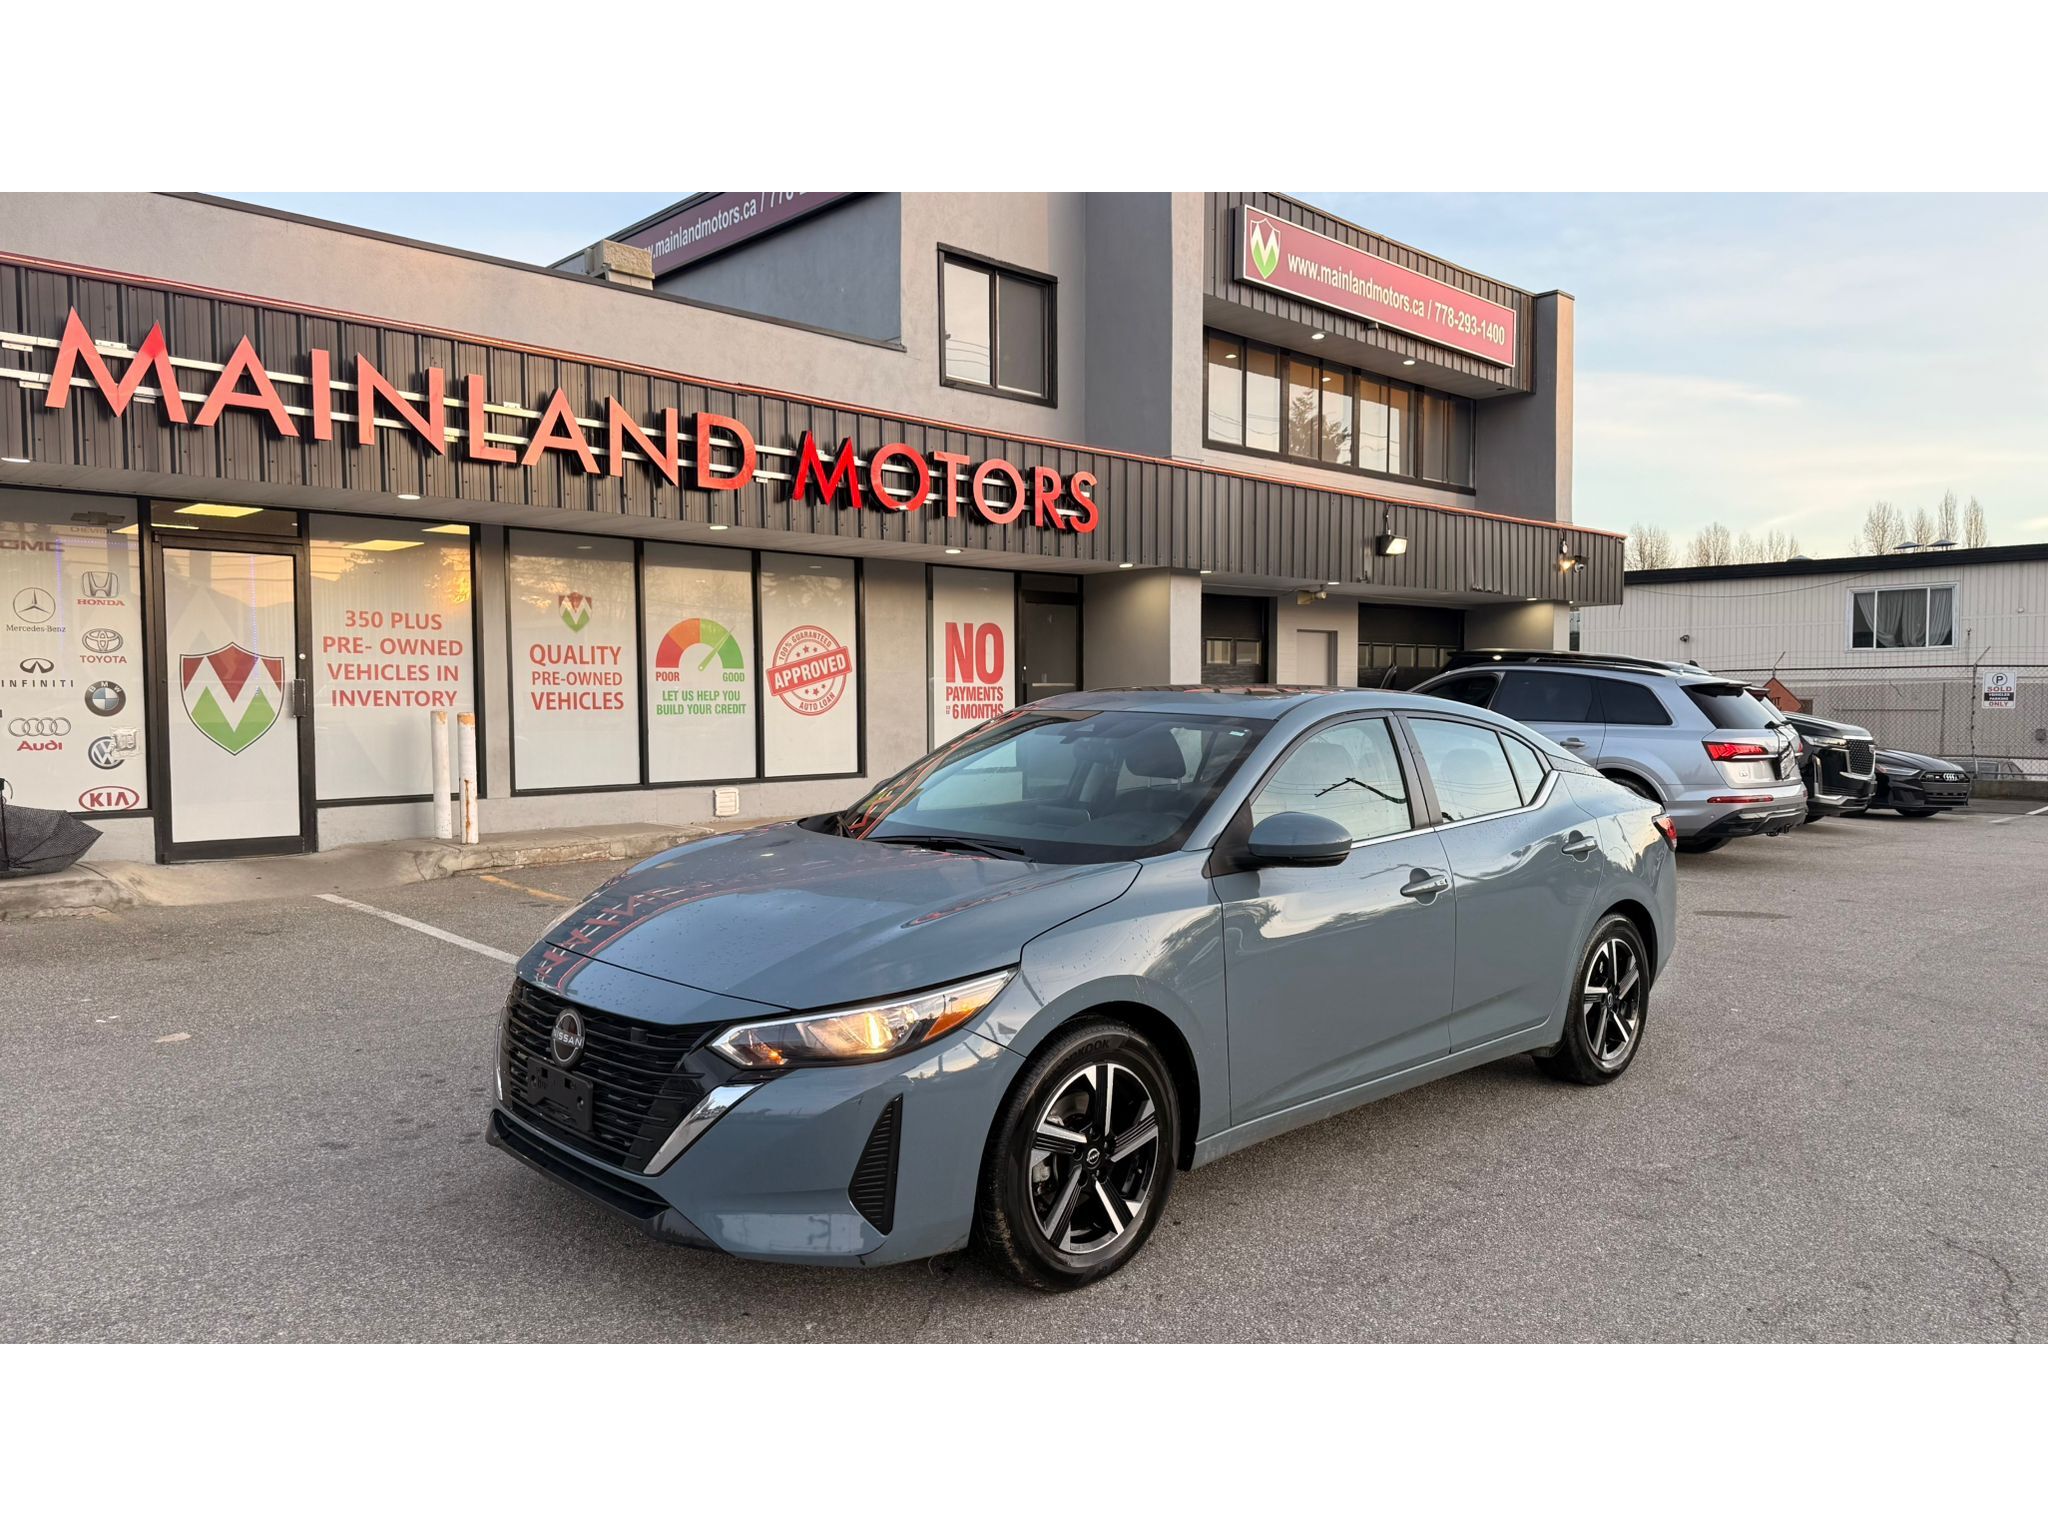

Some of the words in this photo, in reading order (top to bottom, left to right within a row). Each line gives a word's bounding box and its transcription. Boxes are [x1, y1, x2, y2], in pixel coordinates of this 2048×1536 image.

[1288, 253, 1425, 317] www.mainlandmotors.ca
[1427, 300, 1432, 319] /
[1435, 302, 1505, 346] 778-293-1400
[45, 306, 757, 491] MAINLAND
[793, 430, 1098, 534] MOTORS
[0, 539, 65, 553] GMC
[77, 598, 125, 606] HONDA
[345, 610, 383, 628] 350
[391, 612, 442, 630] PLUS
[6, 624, 66, 633] Mercedes-Benz
[380, 638, 463, 656] OWNED
[779, 642, 792, 660] 100%
[792, 631, 832, 647] GUARANTEED
[945, 622, 1004, 684] NO
[80, 655, 127, 664] TOYOTA
[530, 643, 622, 667] QUALITY
[327, 663, 429, 682] VEHICLES
[437, 665, 459, 682] IN
[532, 671, 622, 686] PRE-OWNED
[656, 671, 680, 682] POOR
[722, 672, 745, 682] GOOD
[774, 653, 846, 689] APPROVED
[1, 680, 74, 688] INFINITI
[331, 690, 457, 707] INVENTORY
[531, 691, 624, 710] VEHICLES
[662, 690, 678, 701] LET
[682, 690, 694, 701] US
[697, 691, 719, 701] HELP
[722, 691, 740, 701] YOU
[799, 701, 818, 711] AUTO
[819, 691, 836, 709] LOAN
[946, 686, 1003, 701] PAYMENTS
[656, 704, 684, 715] BUILD
[687, 704, 712, 715] YOUR
[715, 704, 746, 714] CREDIT
[952, 704, 959, 720] 6
[961, 704, 1003, 719] MONTHS
[17, 740, 62, 751] Audi
[90, 792, 129, 807] KIA
[553, 1028, 582, 1047] NISSAN
